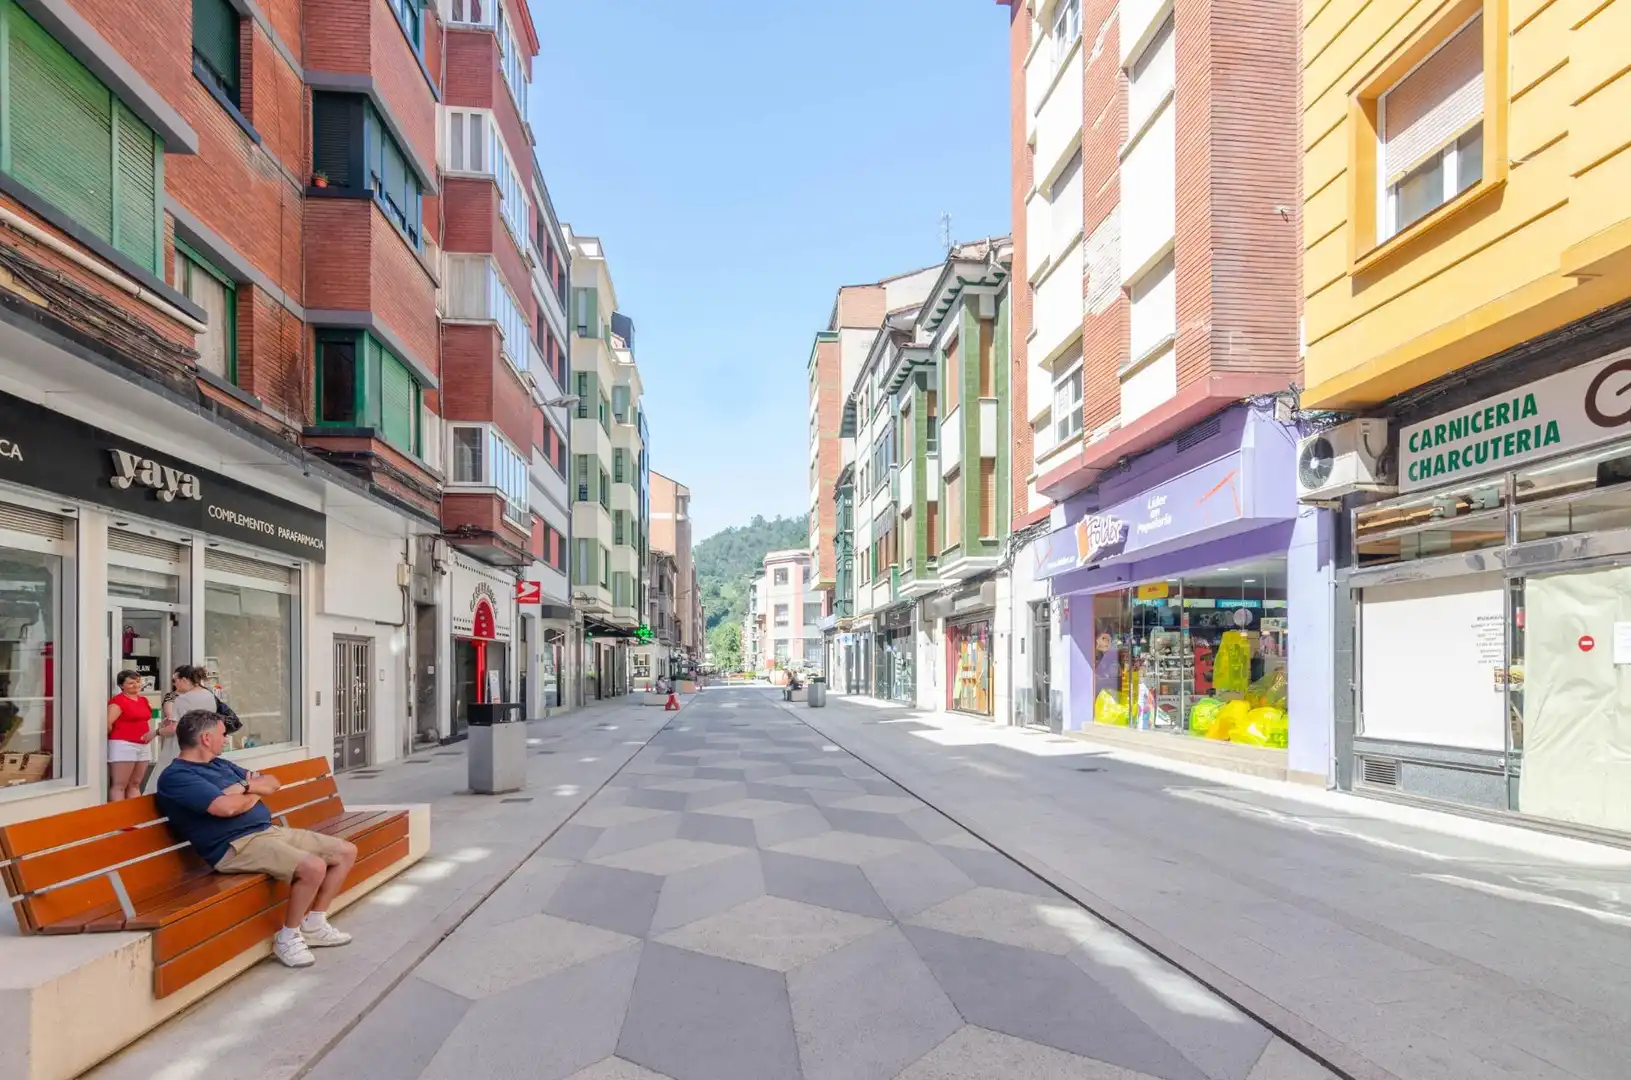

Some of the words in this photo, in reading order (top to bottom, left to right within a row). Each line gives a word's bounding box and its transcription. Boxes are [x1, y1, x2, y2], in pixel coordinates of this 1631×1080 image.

[1407, 420, 1561, 482] CHARCUTERIA
[1408, 392, 1539, 454] CARNICERIA
[108, 447, 203, 503] yaya
[208, 504, 275, 536] COMPLEMENTOS
[277, 526, 325, 551] PARAFARMACIA
